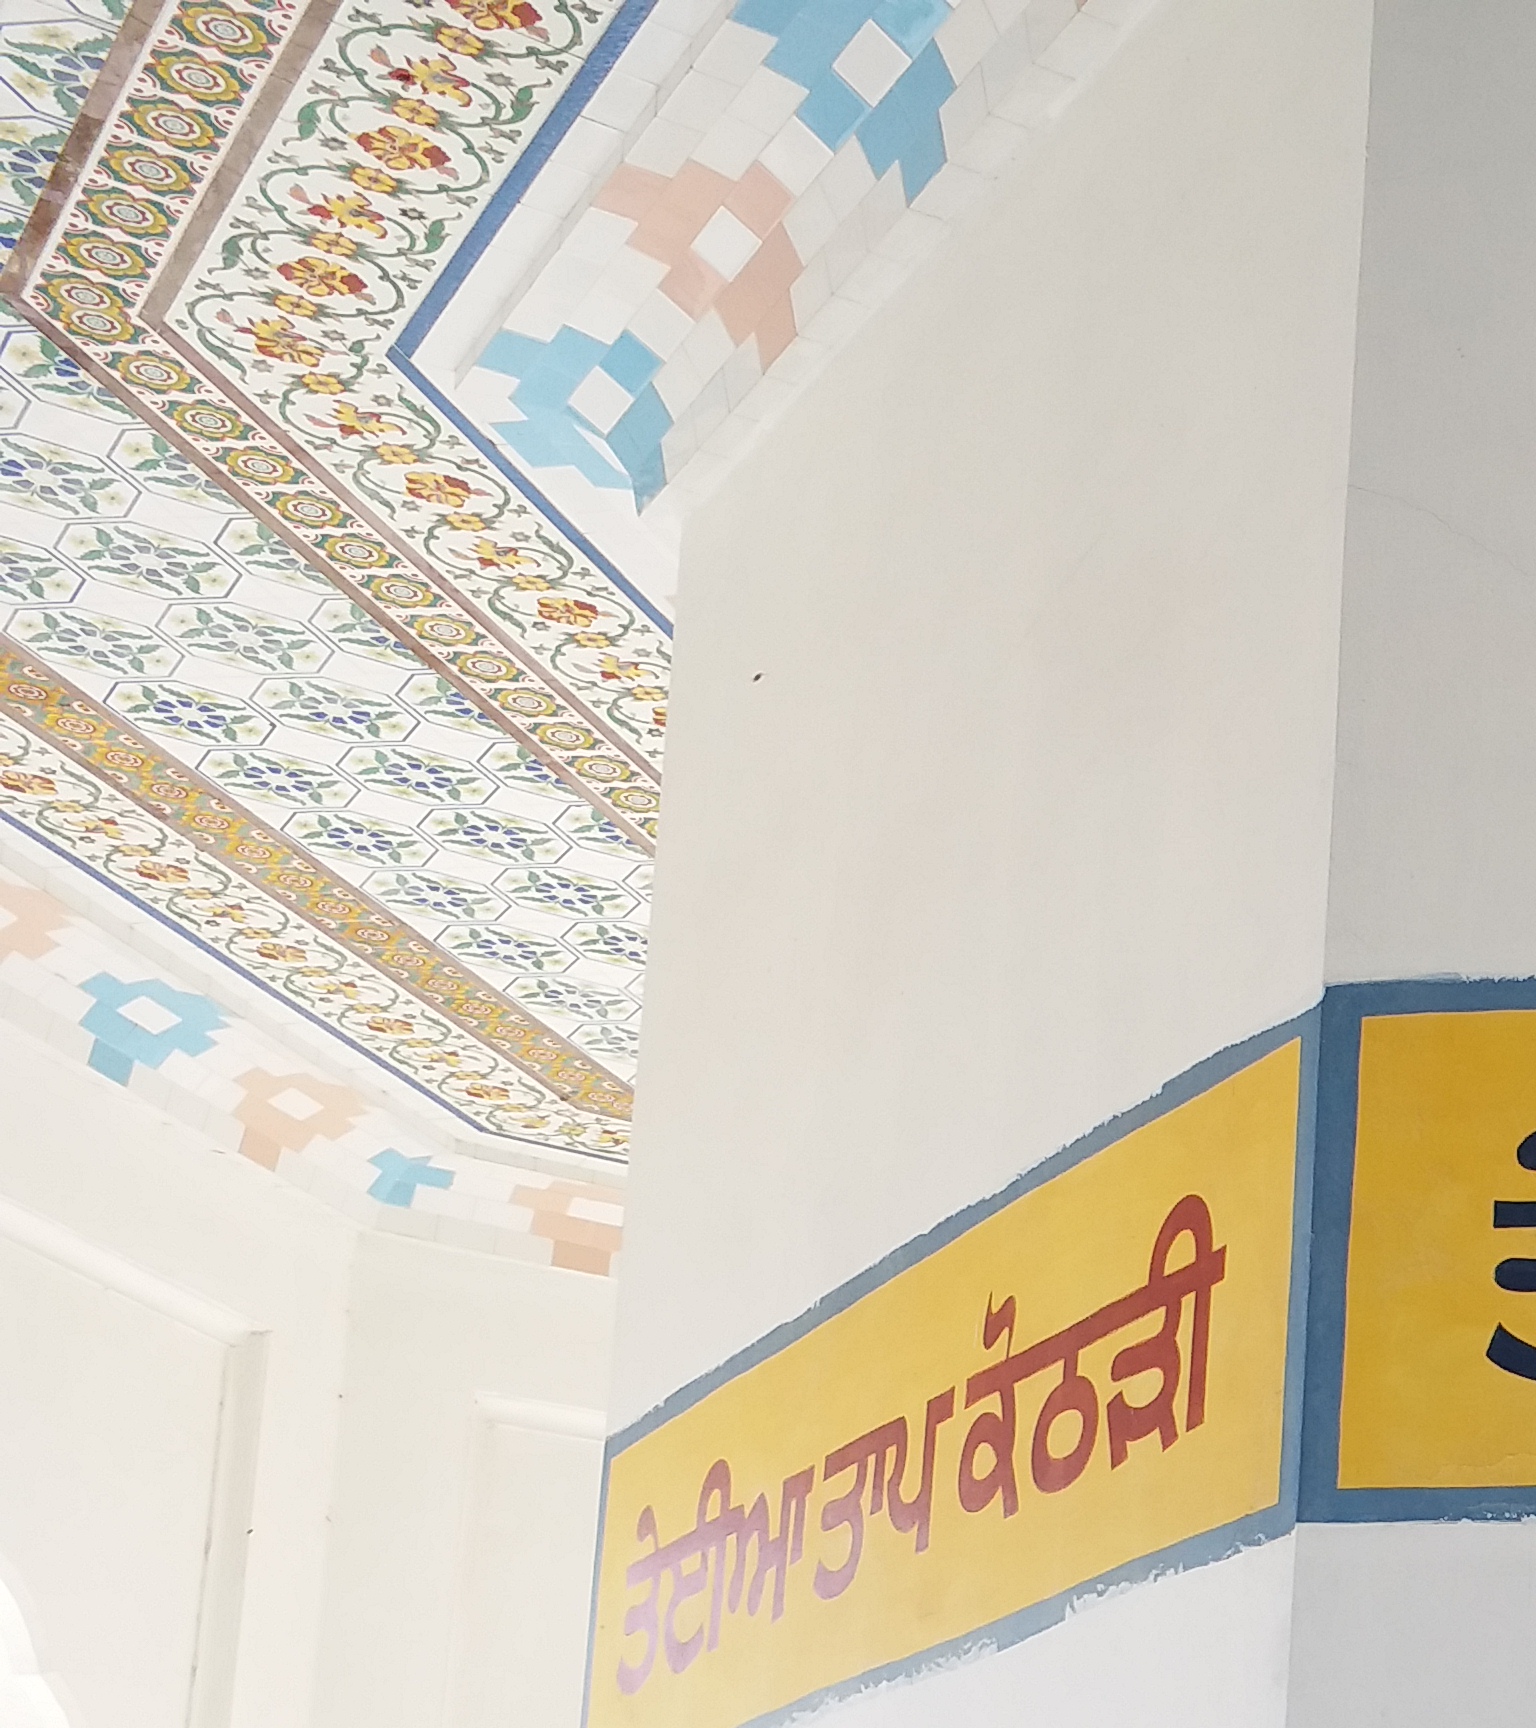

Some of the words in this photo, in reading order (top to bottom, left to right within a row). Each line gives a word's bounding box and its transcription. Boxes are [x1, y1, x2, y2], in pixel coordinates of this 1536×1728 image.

[614, 1458, 816, 1696] ਤੇਈਆ
[813, 1386, 956, 1602] ਤਾਪ
[957, 1193, 1228, 1521] ਕੋਠੜੀ
